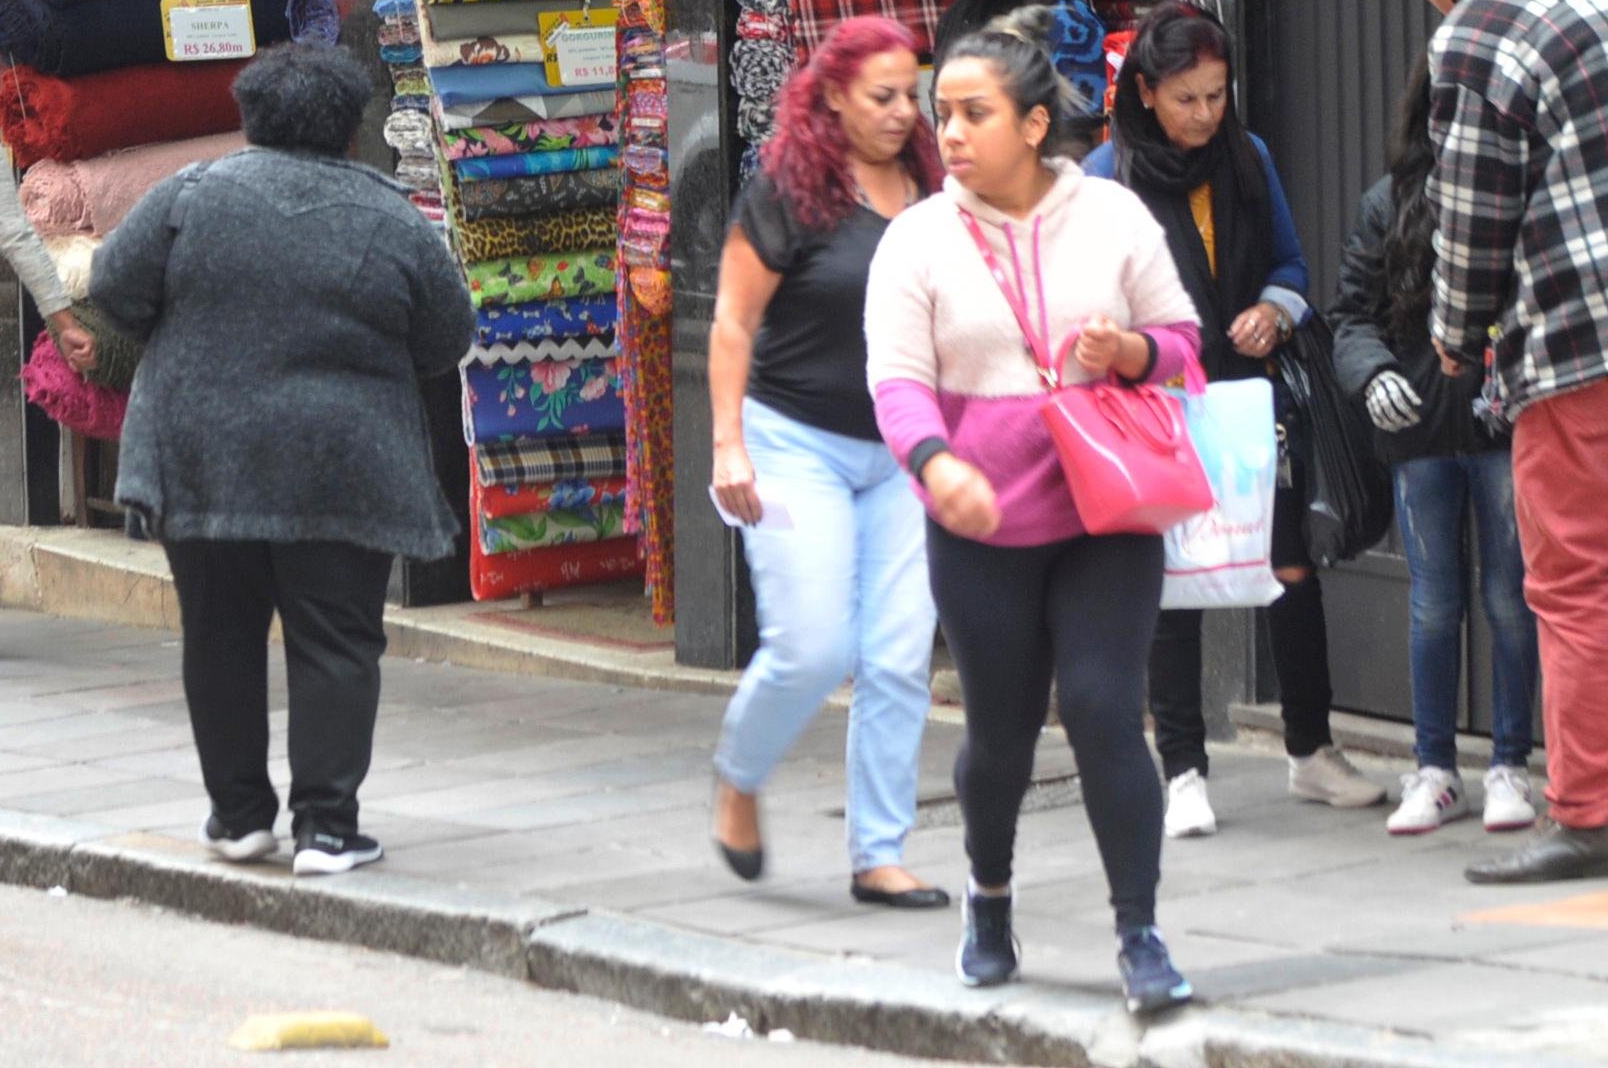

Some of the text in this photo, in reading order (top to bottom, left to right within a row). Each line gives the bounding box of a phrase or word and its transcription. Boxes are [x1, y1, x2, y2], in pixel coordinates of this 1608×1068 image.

[191, 20, 230, 31] SHERPA
[184, 43, 200, 55] R$
[575, 67, 589, 77] R$
